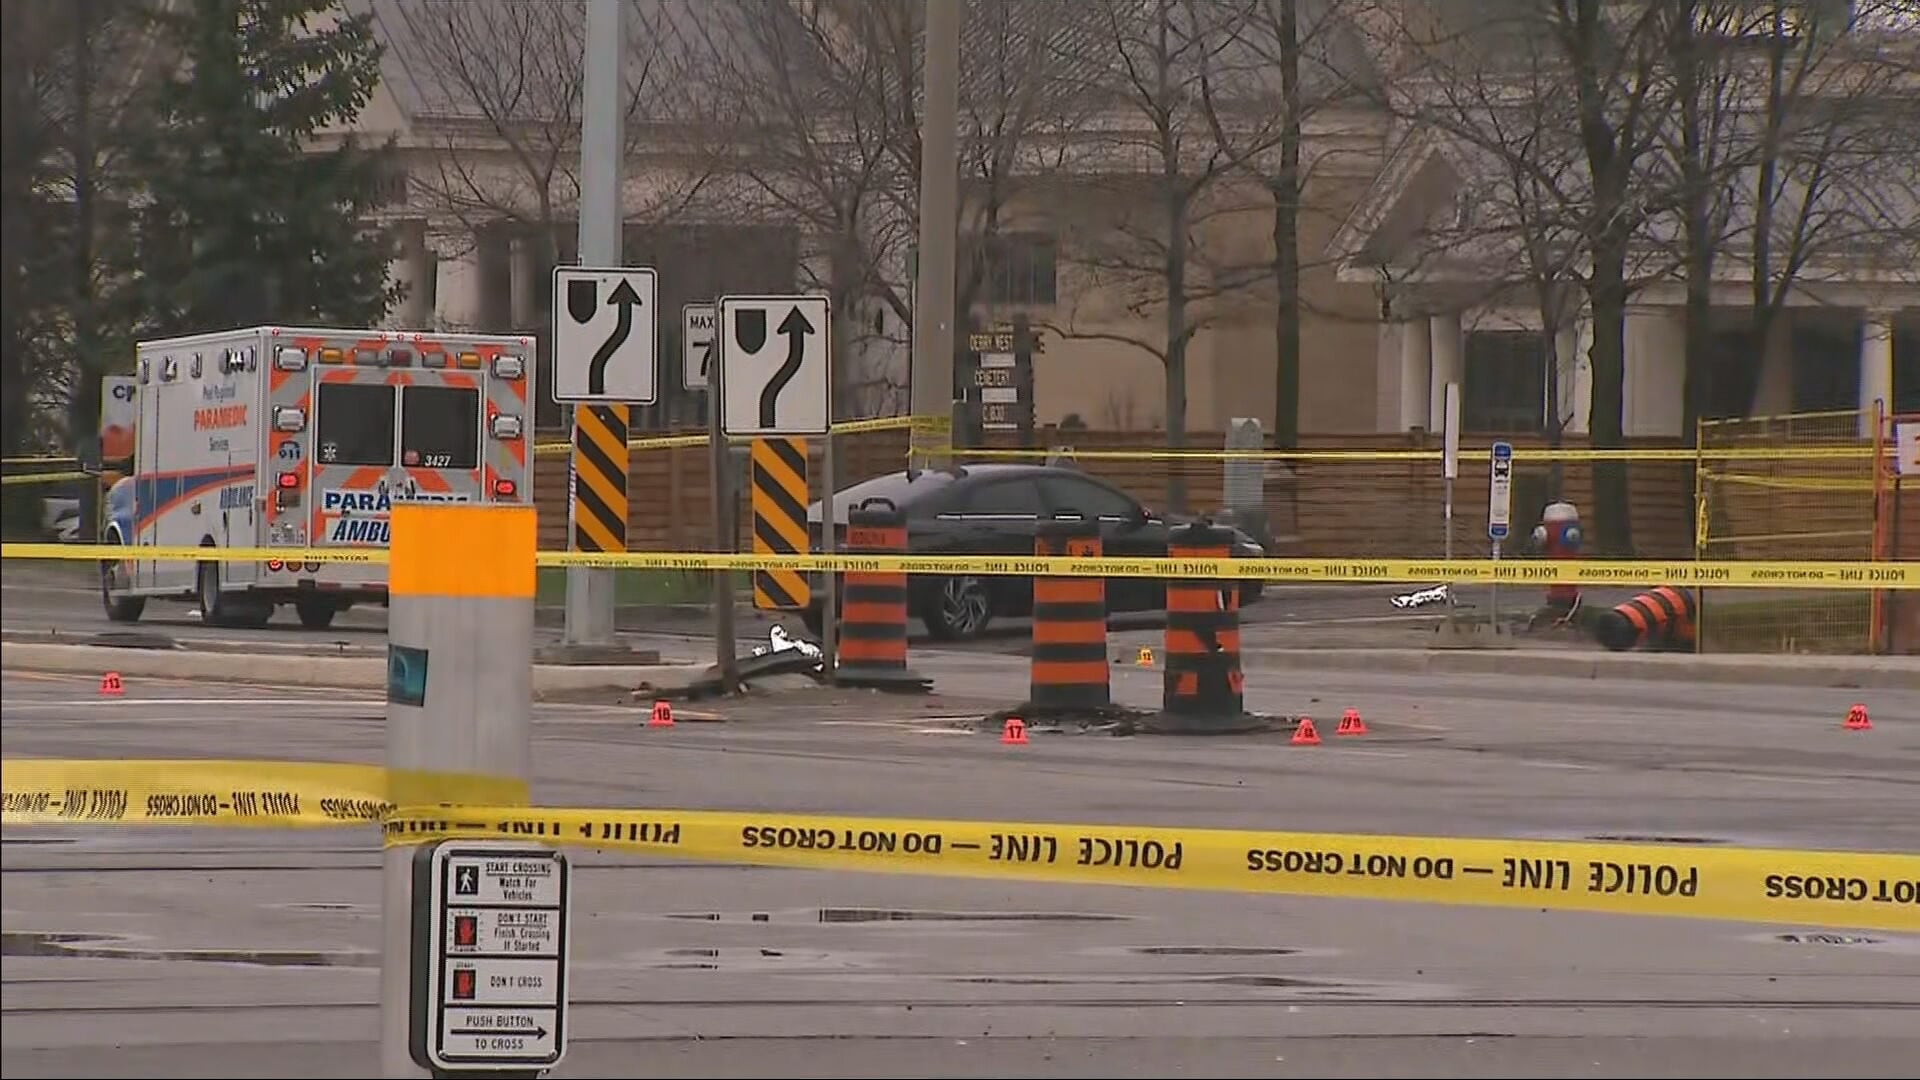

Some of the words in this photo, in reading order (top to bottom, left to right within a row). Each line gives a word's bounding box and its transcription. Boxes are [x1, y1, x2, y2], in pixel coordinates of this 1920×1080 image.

[693, 342, 712, 376] 7
[194, 404, 248, 432] PARAMEDIC
[424, 455, 451, 466] 3427
[1850, 710, 1862, 722] 20
[1008, 726, 1022, 738] 17
[146, 794, 180, 816] CROSS
[180, 794, 201, 816] NOT
[202, 794, 217, 816] DO
[232, 792, 257, 816] LINE
[742, 826, 836, 850] CROSS
[838, 830, 896, 852] NOT
[903, 833, 942, 854] DO
[988, 834, 1057, 863] LINE
[1077, 838, 1182, 870] POLICE
[1246, 850, 1344, 875] CROSS
[486, 862, 508, 873] START
[513, 862, 551, 873] CROSSING
[1346, 854, 1406, 878] NOT
[1412, 856, 1454, 880] DO
[1502, 858, 1570, 890] LINE
[499, 878, 520, 888] Watch
[1588, 862, 1698, 897] POLICE
[1765, 874, 1868, 901] CROSS
[503, 890, 532, 900] Vehicles
[1872, 880, 1920, 904] OT
[525, 913, 547, 923] START
[494, 928, 515, 938] Finish
[520, 928, 550, 941] Crossing
[514, 940, 540, 951] Started
[518, 976, 542, 988] CROSS
[466, 1015, 492, 1026] PUSH
[497, 1016, 534, 1027] BUTTON
[475, 1039, 487, 1050] TO
[492, 1039, 524, 1050] CROSS
